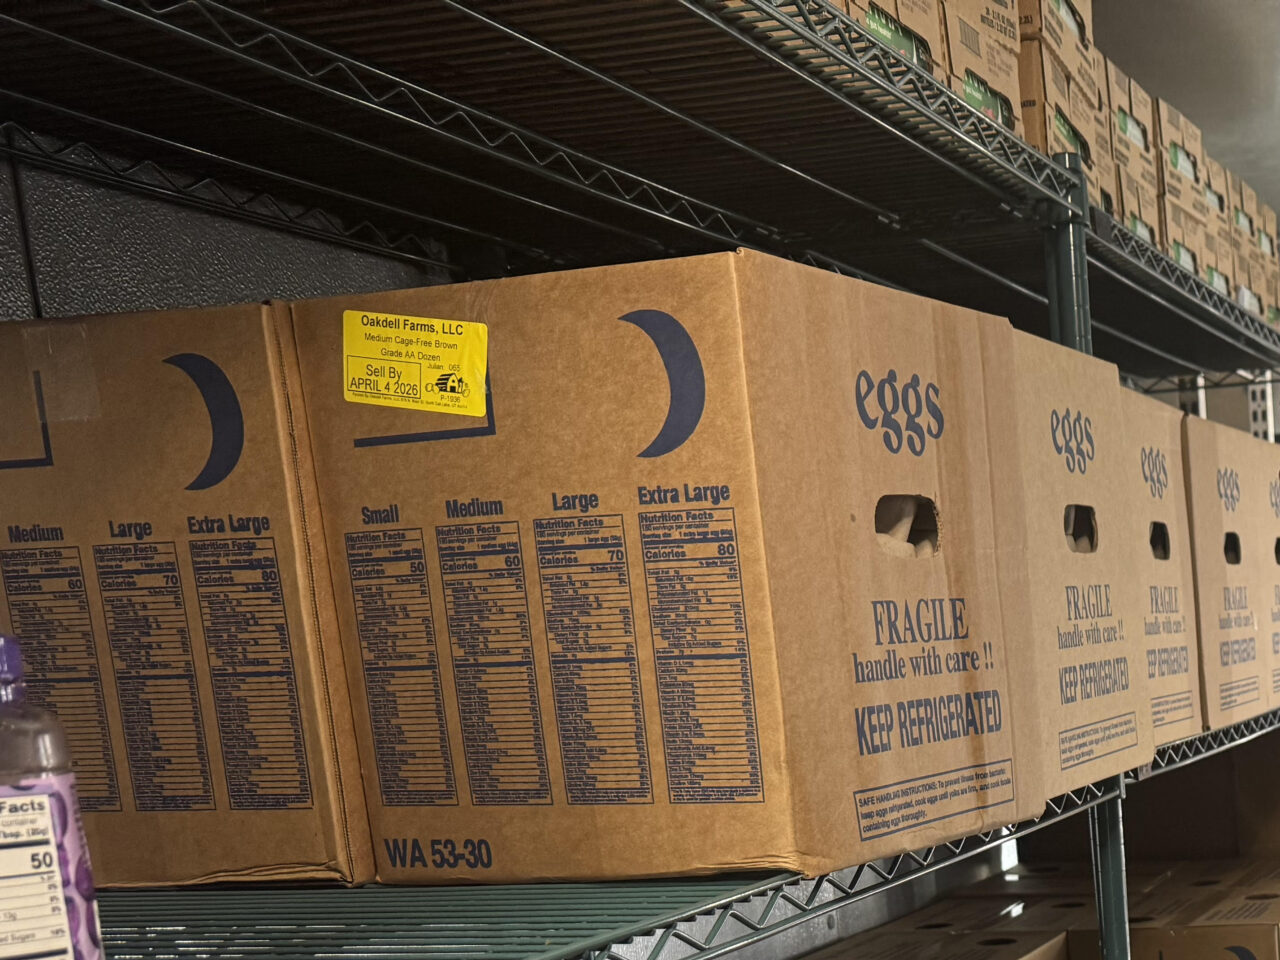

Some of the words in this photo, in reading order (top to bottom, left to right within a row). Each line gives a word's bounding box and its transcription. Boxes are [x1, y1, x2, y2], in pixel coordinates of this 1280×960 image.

[361, 314, 400, 330] Oakdell
[403, 319, 440, 335] Farms,
[442, 322, 464, 336] LLC
[364, 332, 393, 344] Medium
[394, 335, 433, 349] Cage-Free
[434, 339, 459, 350] Brown
[380, 347, 403, 358] Grade
[404, 351, 416, 359] AA
[417, 351, 441, 362] Dozen
[366, 363, 387, 378] Sell
[388, 366, 402, 383] By
[350, 376, 382, 393] APRIL
[384, 380, 391, 393] 4
[393, 381, 419, 396] 2026
[855, 369, 945, 457] eggs
[1050, 407, 1095, 475] eggs
[1141, 446, 1169, 500] eggs
[637, 485, 681, 505] Extra
[683, 483, 731, 505] Large
[1217, 466, 1240, 512] eggs
[445, 497, 504, 519] Medium
[552, 492, 600, 513] Large
[361, 503, 400, 525] Small
[535, 520, 575, 530] Nutrition
[577, 518, 604, 527] Facts
[640, 513, 683, 523] Nutrition
[685, 511, 714, 521] Facts
[7, 524, 65, 543] Medium
[109, 519, 153, 541] Large
[187, 514, 227, 534] Extra
[228, 513, 271, 536] Large
[607, 549, 624, 561] 70
[645, 549, 686, 560] Calories
[717, 543, 736, 556] 80
[410, 562, 425, 573] 50
[442, 562, 479, 572] Calories
[504, 555, 521, 568] 60
[540, 555, 579, 565] Calories
[162, 574, 179, 586] 70
[197, 574, 235, 584] Calories
[262, 570, 278, 582] 80
[352, 568, 386, 577] Calories
[7, 583, 43, 593] Calories
[67, 578, 83, 590] 60
[101, 579, 137, 589] Calories
[1065, 583, 1113, 621] FRAGILE
[1149, 585, 1179, 614] FRAGILE
[871, 597, 970, 647] FRAGILE
[1057, 624, 1084, 650] handle
[1085, 621, 1102, 645] with
[1103, 626, 1118, 643] care
[852, 649, 907, 684] handle
[909, 646, 943, 677] with
[945, 649, 981, 674] care
[983, 641, 995, 670] !!
[1059, 665, 1079, 706] KEEP
[1079, 656, 1130, 701] REFRIGERATED
[854, 703, 895, 757] KEEP
[897, 689, 1003, 749] REFRIGERATED
[859, 795, 876, 808] SAFE
[900, 782, 938, 800] INSTRUCTIONS:
[938, 780, 945, 789] To
[863, 818, 891, 833] containing
[30, 852, 53, 869] 50
[384, 838, 428, 868] WA
[430, 838, 493, 869] 53-30
